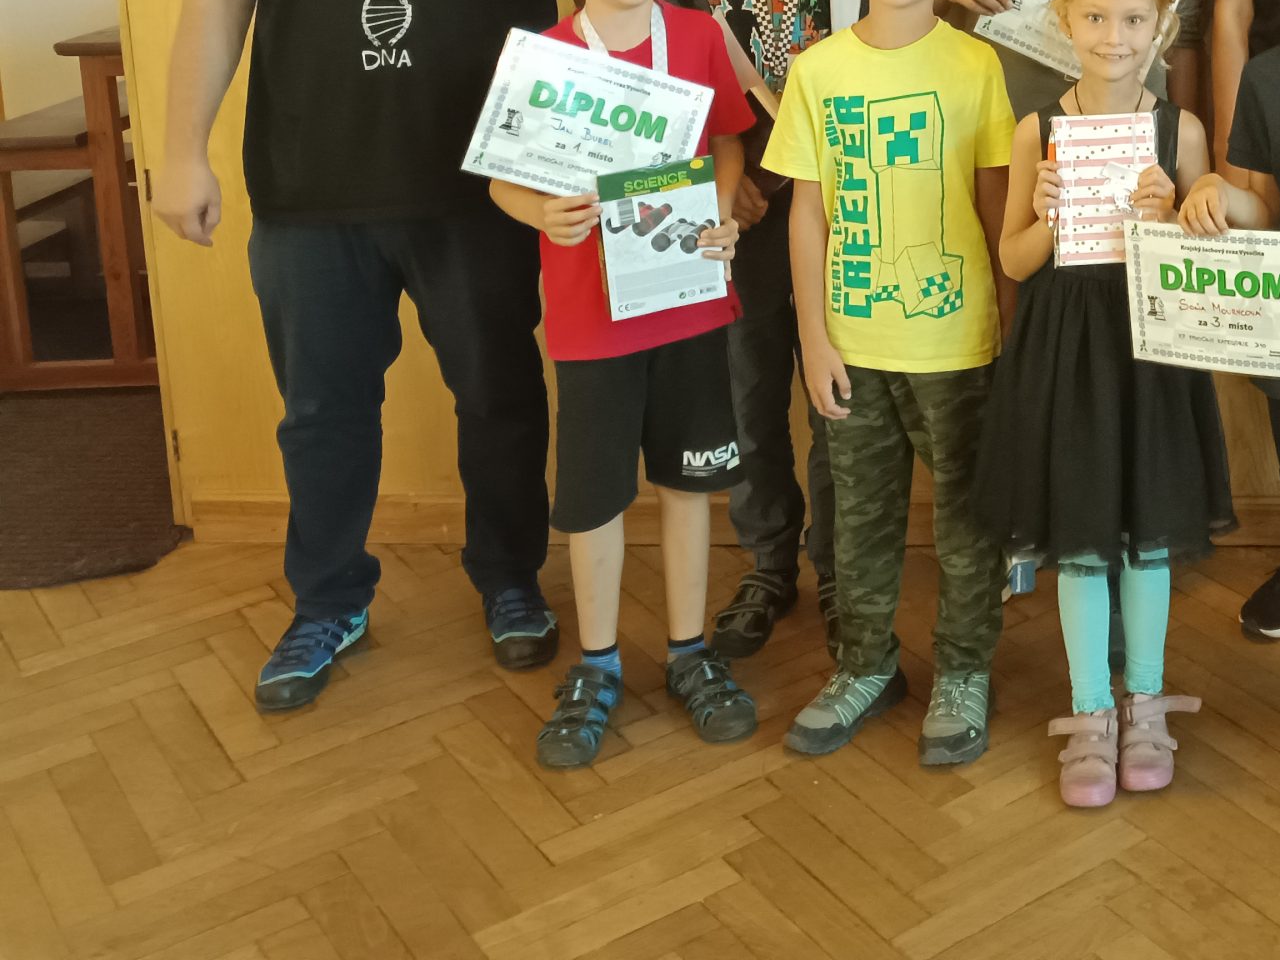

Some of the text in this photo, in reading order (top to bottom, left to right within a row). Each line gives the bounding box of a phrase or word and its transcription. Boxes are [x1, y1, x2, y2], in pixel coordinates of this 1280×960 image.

[362, 48, 412, 70] DNA
[529, 79, 668, 143] DIPLOM
[555, 141, 566, 151] za
[588, 149, 614, 163] místo
[623, 171, 688, 193] SCIENCE
[833, 95, 872, 319] CREEPER
[1198, 319, 1208, 327] za
[1228, 320, 1254, 331] místo
[683, 441, 739, 466] NASA
